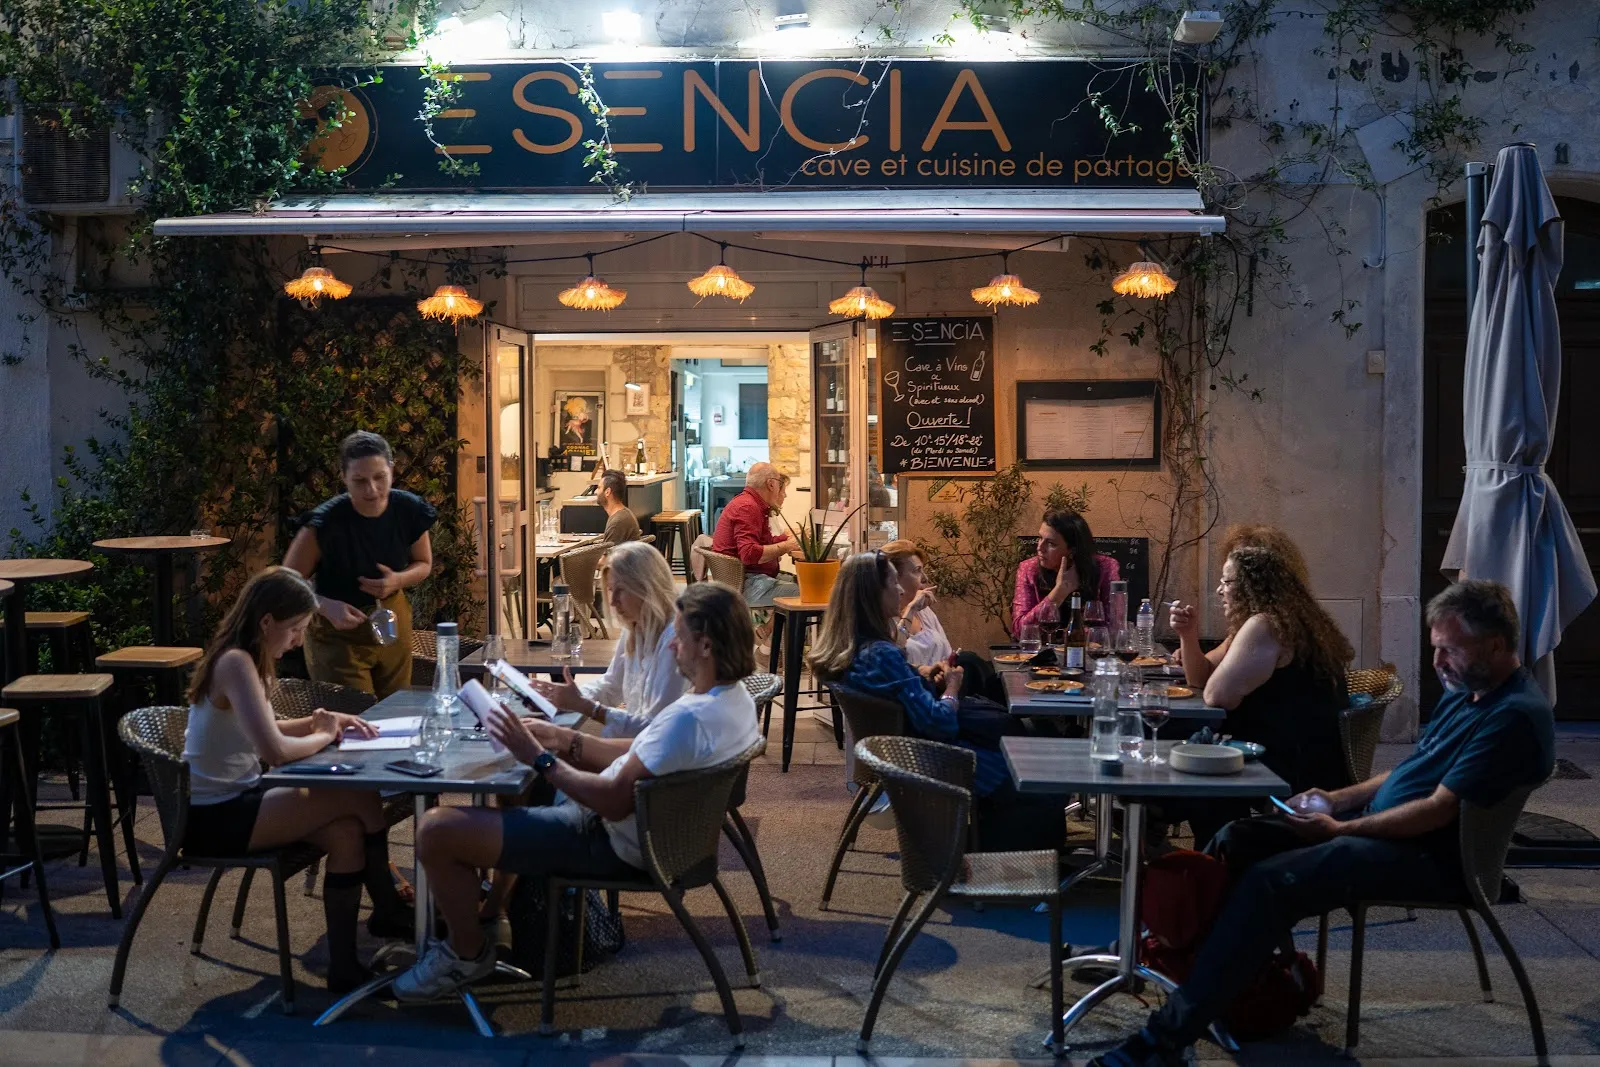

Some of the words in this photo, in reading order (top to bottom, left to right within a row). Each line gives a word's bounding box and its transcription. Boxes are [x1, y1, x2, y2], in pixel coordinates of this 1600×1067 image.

[434, 68, 1012, 155] ESENCIA
[801, 158, 871, 176] cave
[880, 155, 908, 176] et
[917, 152, 1017, 176] cuisine
[1026, 152, 1063, 176] de
[1074, 154, 1192, 184] partage
[904, 356, 933, 372] Cave
[935, 359, 942, 371] à
[945, 355, 968, 372] Vins
[907, 380, 960, 398] Spiritueux
[890, 435, 911, 447] De
